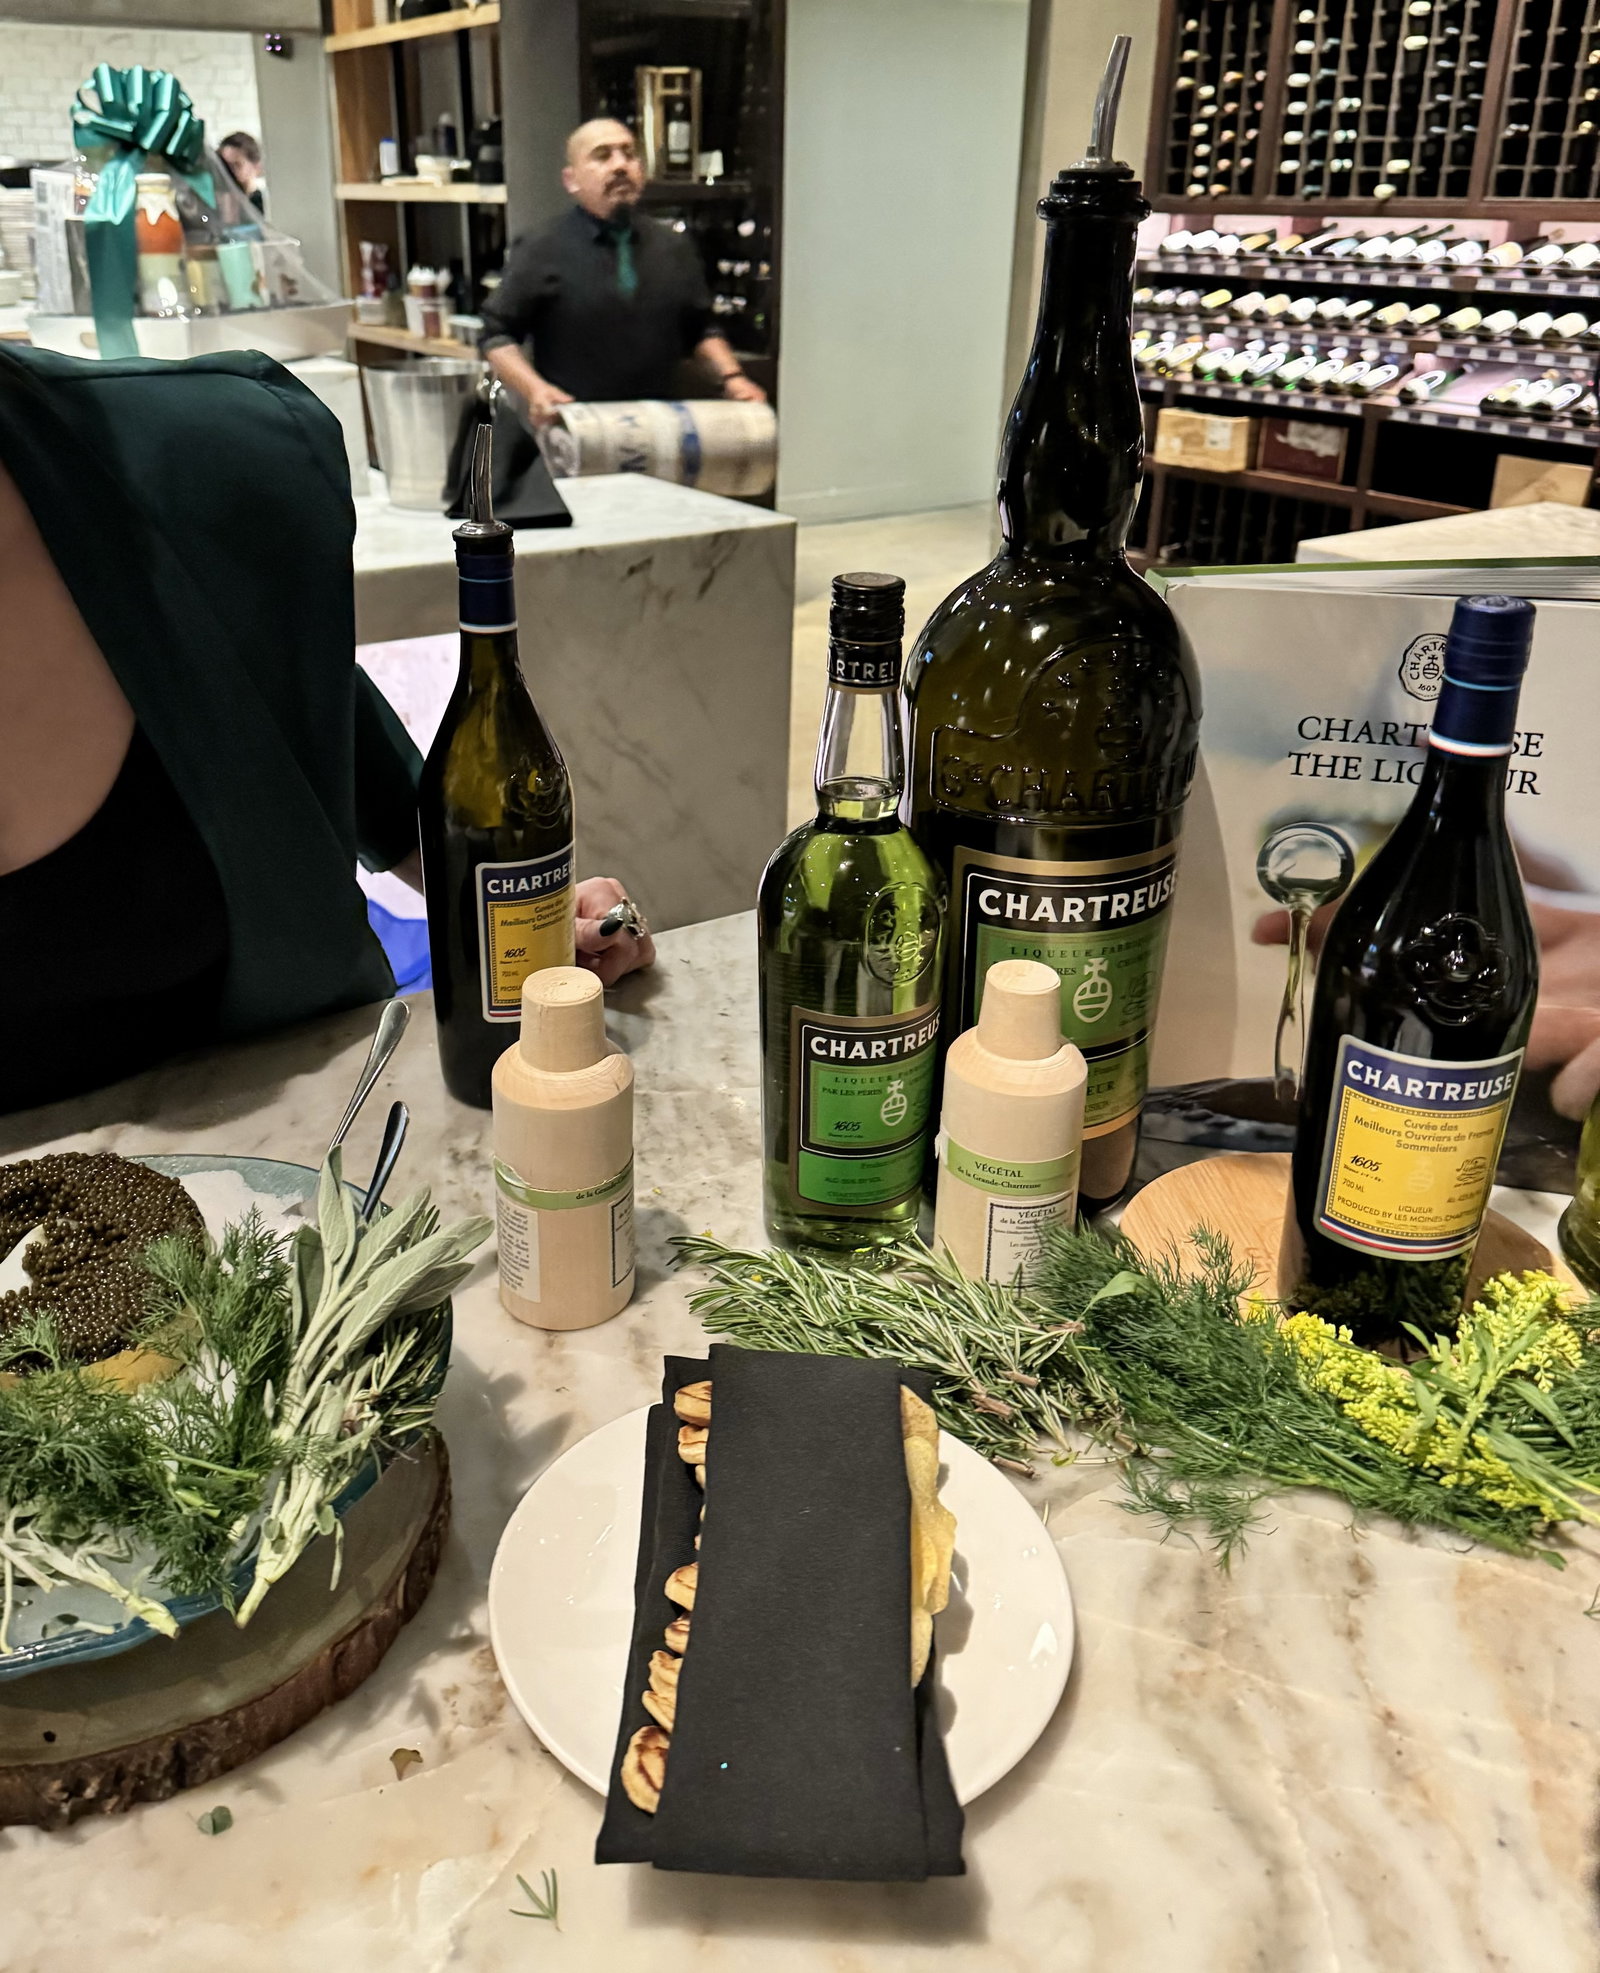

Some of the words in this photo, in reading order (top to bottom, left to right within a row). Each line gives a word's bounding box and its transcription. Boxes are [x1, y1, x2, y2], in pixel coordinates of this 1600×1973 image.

[830, 660, 894, 679] RTRE
[1410, 641, 1447, 680] CHARTR
[1298, 716, 1544, 757] CHARTSE
[1288, 751, 1362, 780] THE
[504, 947, 527, 958] 1605
[1010, 946, 1094, 957] LIQUEUR
[810, 1011, 940, 1060] CHARTREUS
[1347, 1060, 1515, 1101] CHARTREUSE
[834, 1120, 862, 1131] 1605
[1354, 1115, 1401, 1137] Meilleurs
[1404, 1130, 1451, 1142] Ouvriers
[1454, 1132, 1466, 1141] de
[1403, 1119, 1437, 1132] Cuvée
[1440, 1120, 1458, 1131] des
[1395, 1139, 1458, 1152] Sommeliers
[975, 1160, 1023, 1178] VÉGÉTAL
[1350, 1154, 1382, 1172] 1605
[965, 1169, 971, 1177] la
[1018, 1206, 1057, 1218] VÉGÉTAL
[1337, 1195, 1380, 1216] PRODUCED
[1382, 1211, 1392, 1219] BY
